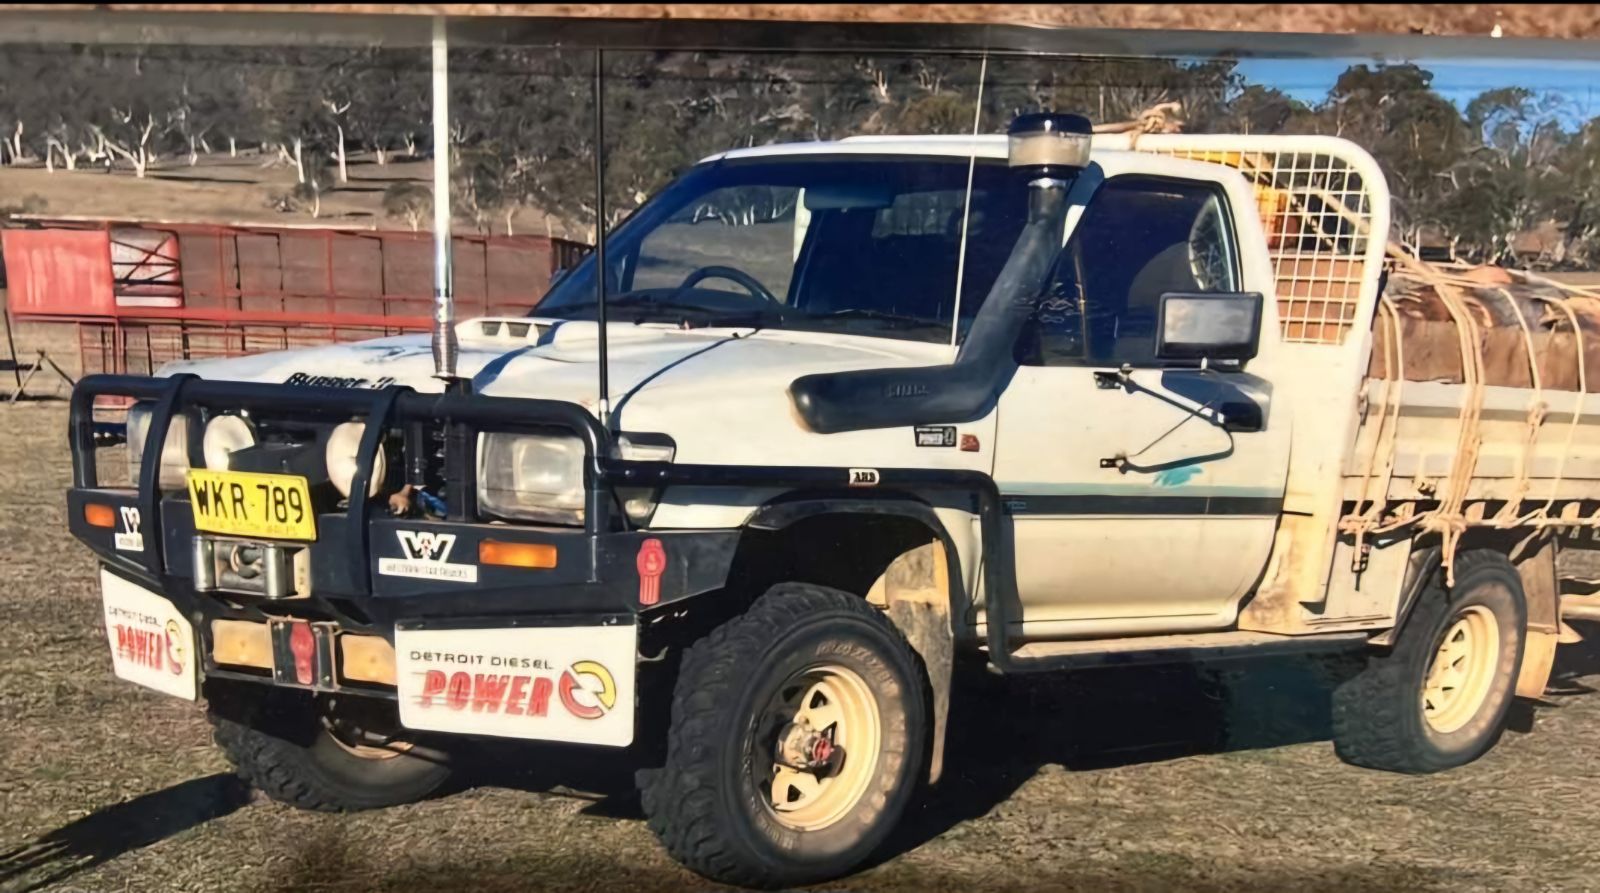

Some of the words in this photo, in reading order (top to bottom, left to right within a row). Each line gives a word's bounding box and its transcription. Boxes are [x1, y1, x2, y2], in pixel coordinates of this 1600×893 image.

[410, 651, 484, 665] DETROIT
[490, 656, 555, 670] DIESEL
[418, 670, 553, 717] POWER
